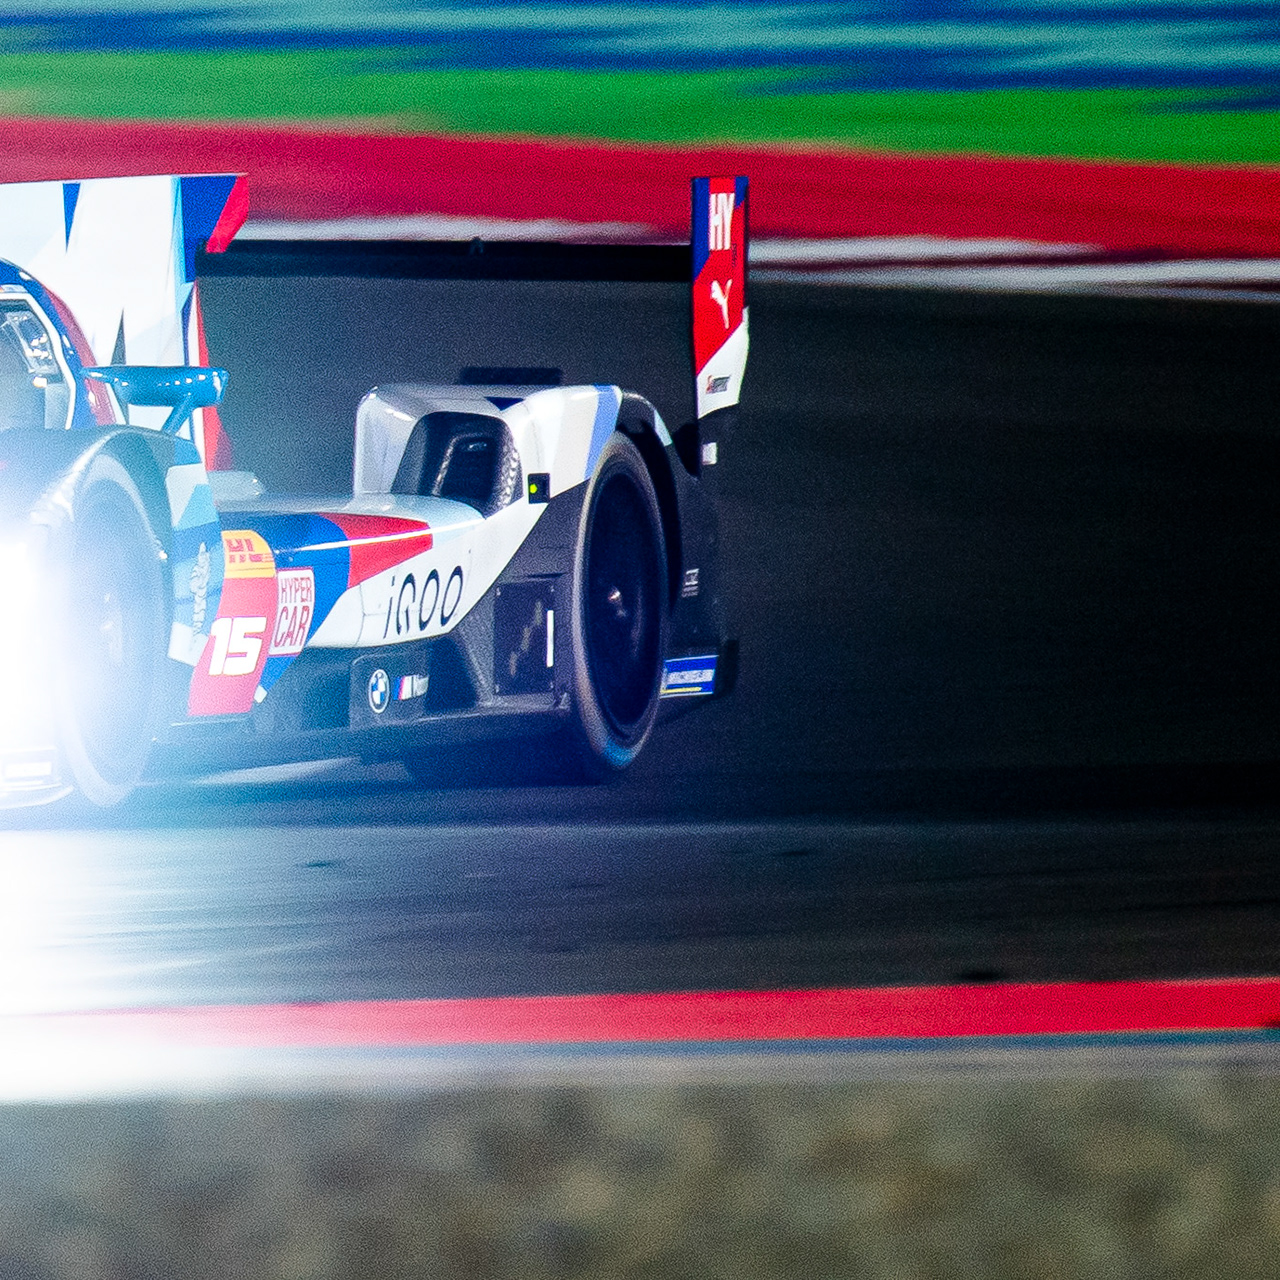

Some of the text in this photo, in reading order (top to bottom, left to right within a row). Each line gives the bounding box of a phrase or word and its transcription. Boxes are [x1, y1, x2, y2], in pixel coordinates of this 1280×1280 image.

[281, 576, 311, 604] HYPER
[383, 565, 464, 639] iQOO
[208, 616, 267, 676] 15
[273, 605, 310, 648] CAR
